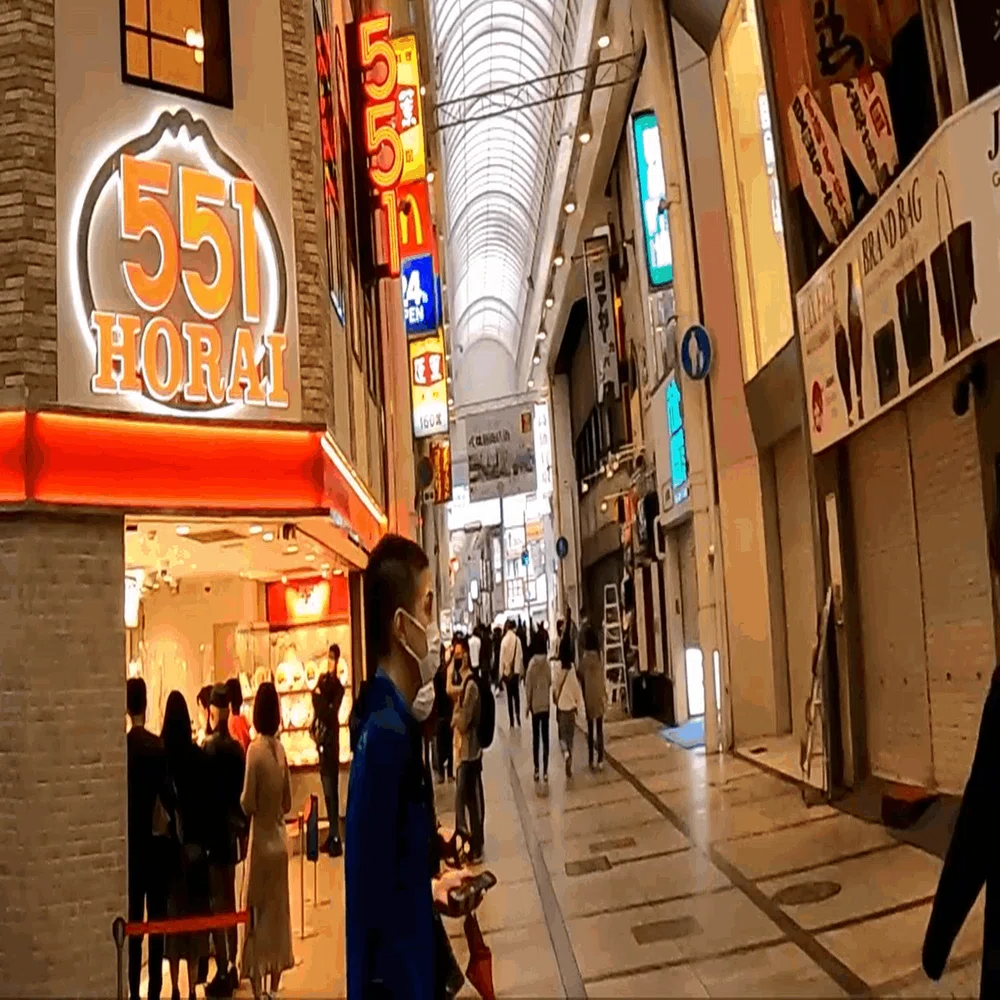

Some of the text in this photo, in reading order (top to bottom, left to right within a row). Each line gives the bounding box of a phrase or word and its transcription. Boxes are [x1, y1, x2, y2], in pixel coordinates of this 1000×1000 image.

[359, 15, 404, 275] 551
[120, 152, 260, 323] 551
[862, 208, 897, 276] BRAND
[897, 177, 922, 240] BAG
[91, 310, 290, 408] HORAI
